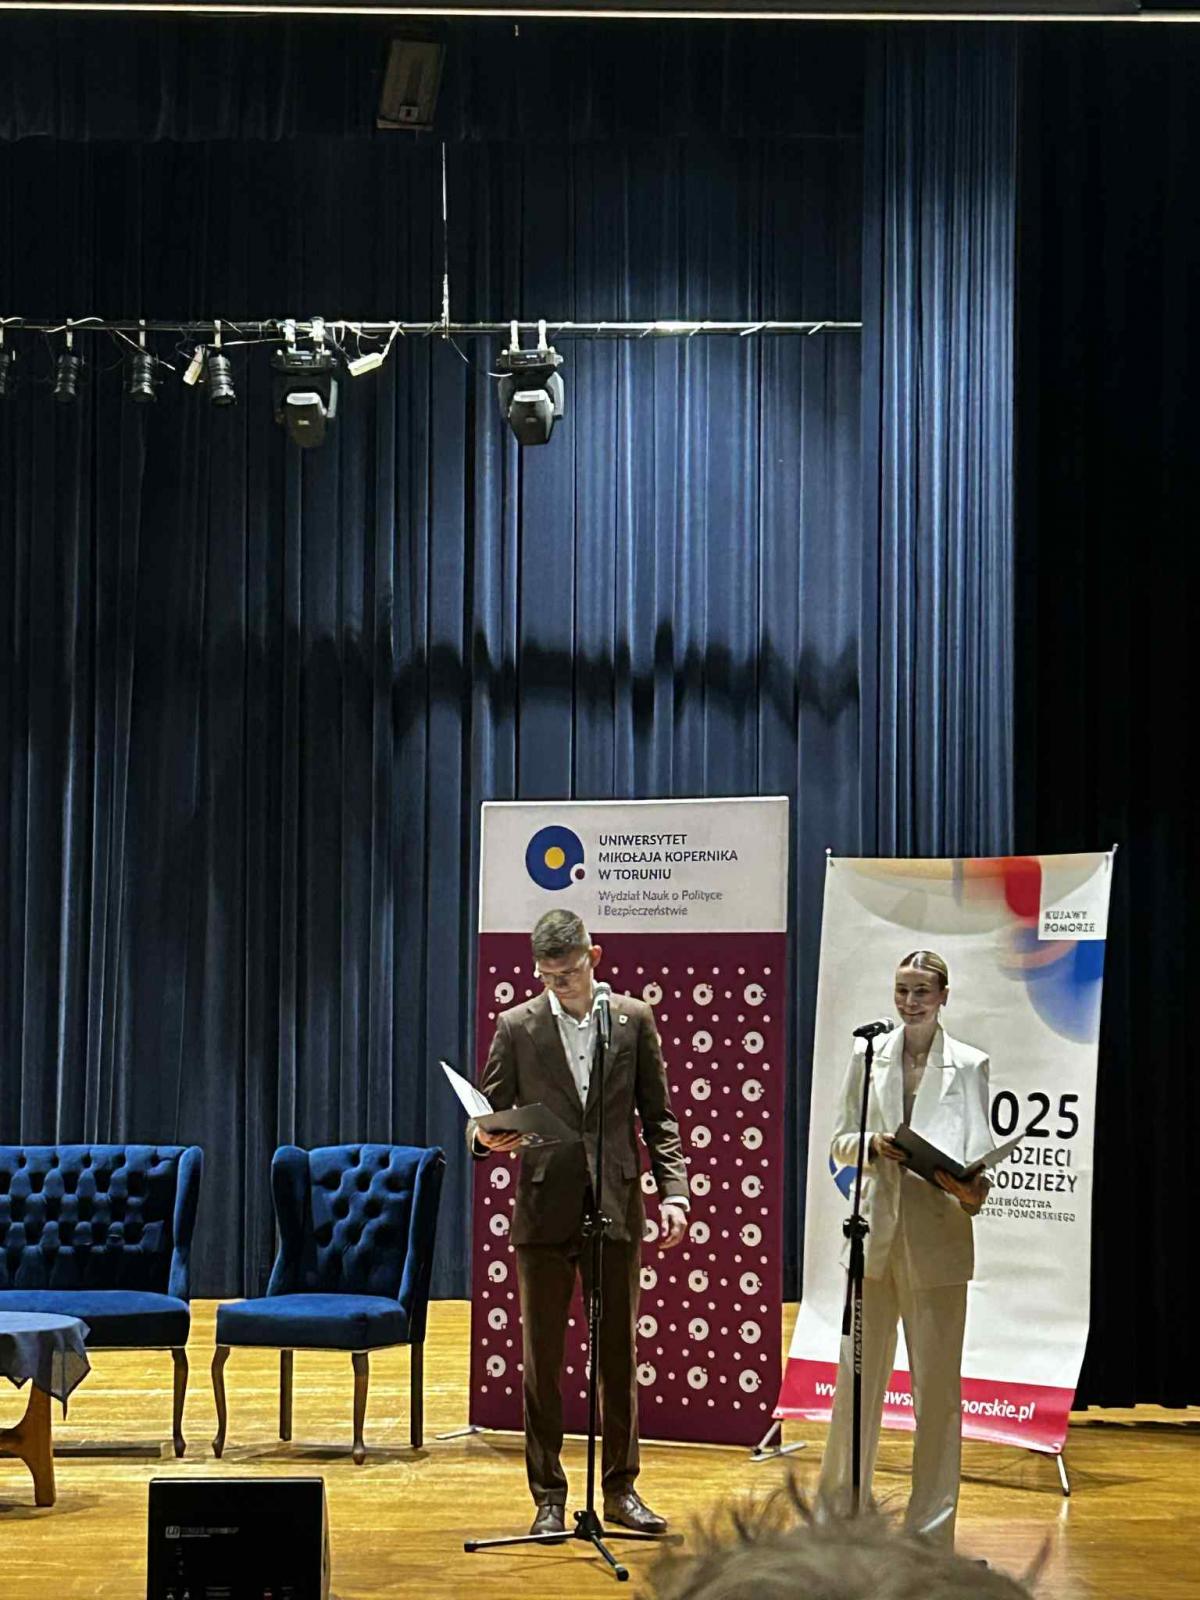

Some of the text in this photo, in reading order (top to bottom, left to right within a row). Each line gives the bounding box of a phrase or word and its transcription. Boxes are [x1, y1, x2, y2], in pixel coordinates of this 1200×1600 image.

[599, 834, 687, 846] UNIWERSYTET
[599, 850, 738, 863] MIKOŁAJA KOPERNIKA
[598, 868, 671, 880] W TORUNIU
[598, 889, 722, 903] Wydział Nauk o Polityce
[604, 905, 688, 918] Bezpieczeństwie
[991, 1091, 1079, 1140] 025
[1010, 1146, 1071, 1167] DZIECI
[988, 1169, 1078, 1193] ODZIEŻY
[985, 1196, 1052, 1209] OJEWÓDZTWA
